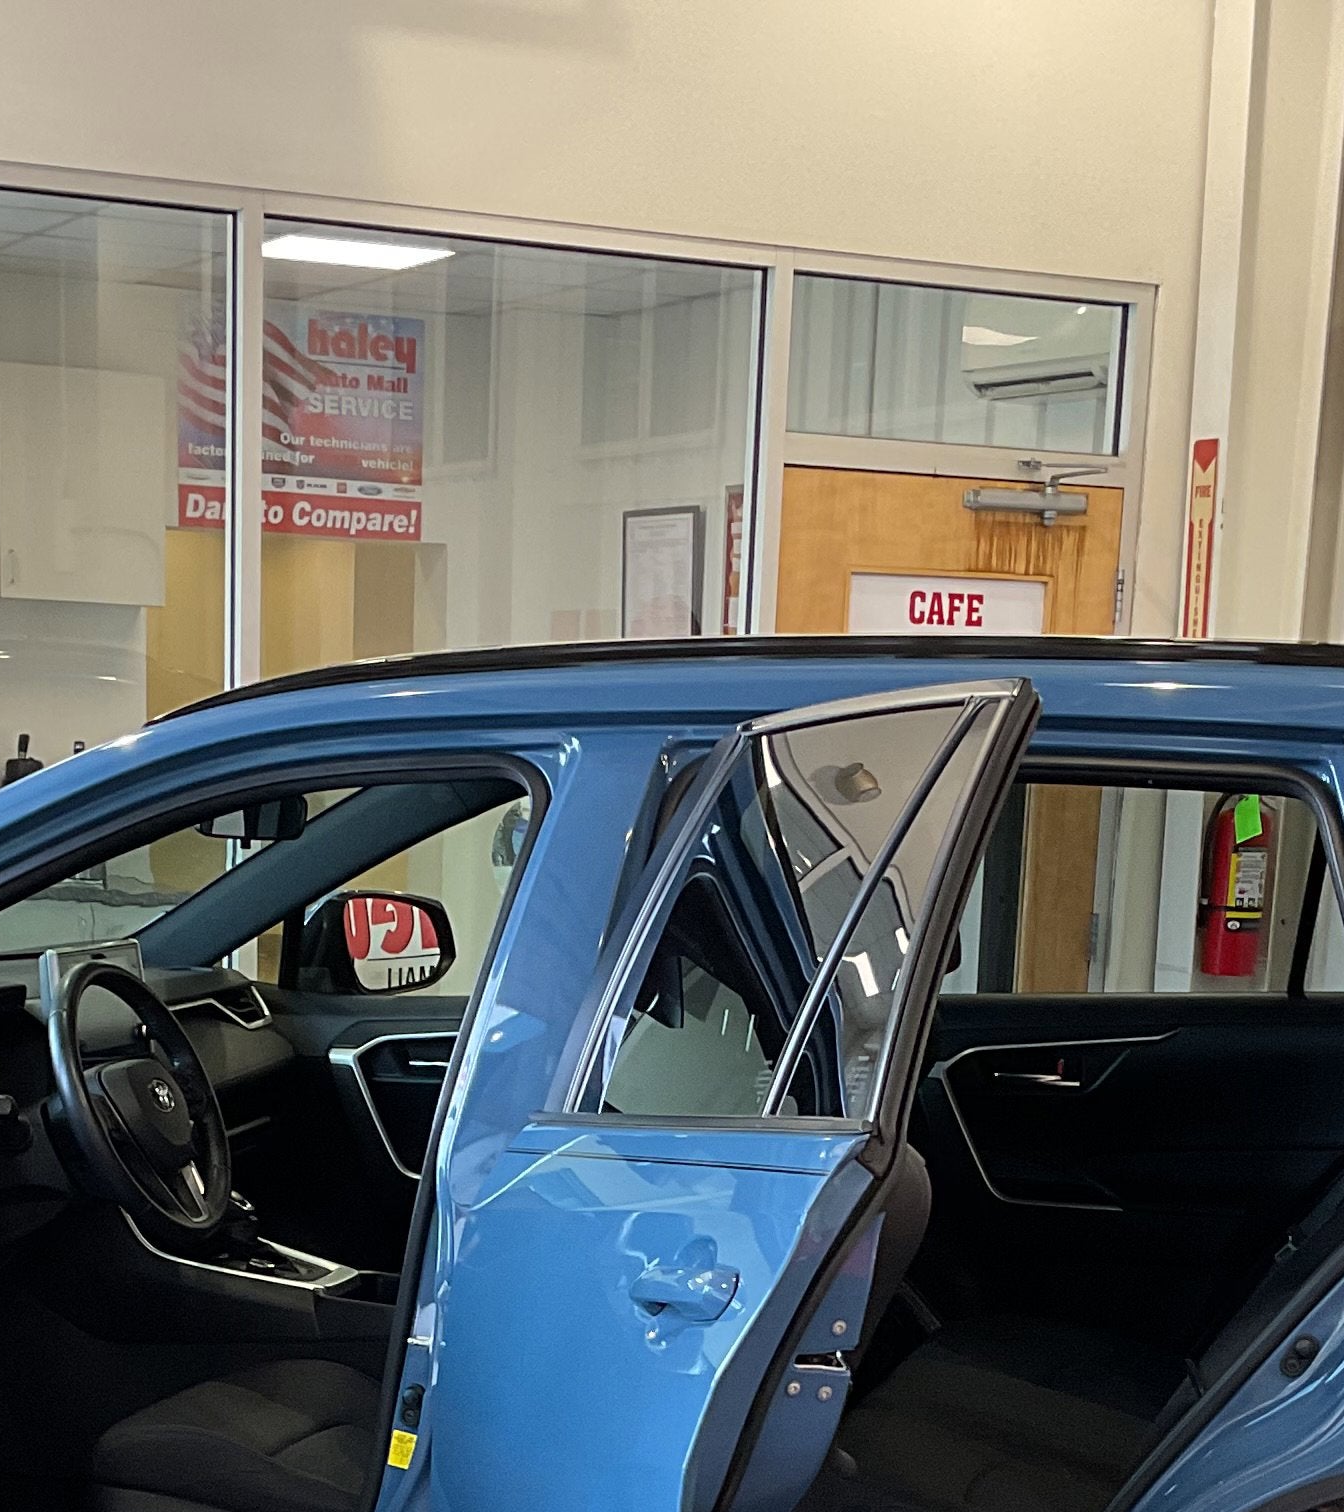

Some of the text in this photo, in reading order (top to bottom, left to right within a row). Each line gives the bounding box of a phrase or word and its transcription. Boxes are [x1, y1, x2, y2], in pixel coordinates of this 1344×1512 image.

[307, 318, 417, 374] haley
[367, 374, 408, 393] Mall
[306, 394, 414, 420] SERVICE
[280, 432, 306, 446] Our
[310, 435, 388, 452] technicians
[295, 451, 315, 465] for
[1194, 485, 1212, 499] FIRE
[292, 500, 418, 535] Compare!
[909, 590, 984, 628] CAFE
